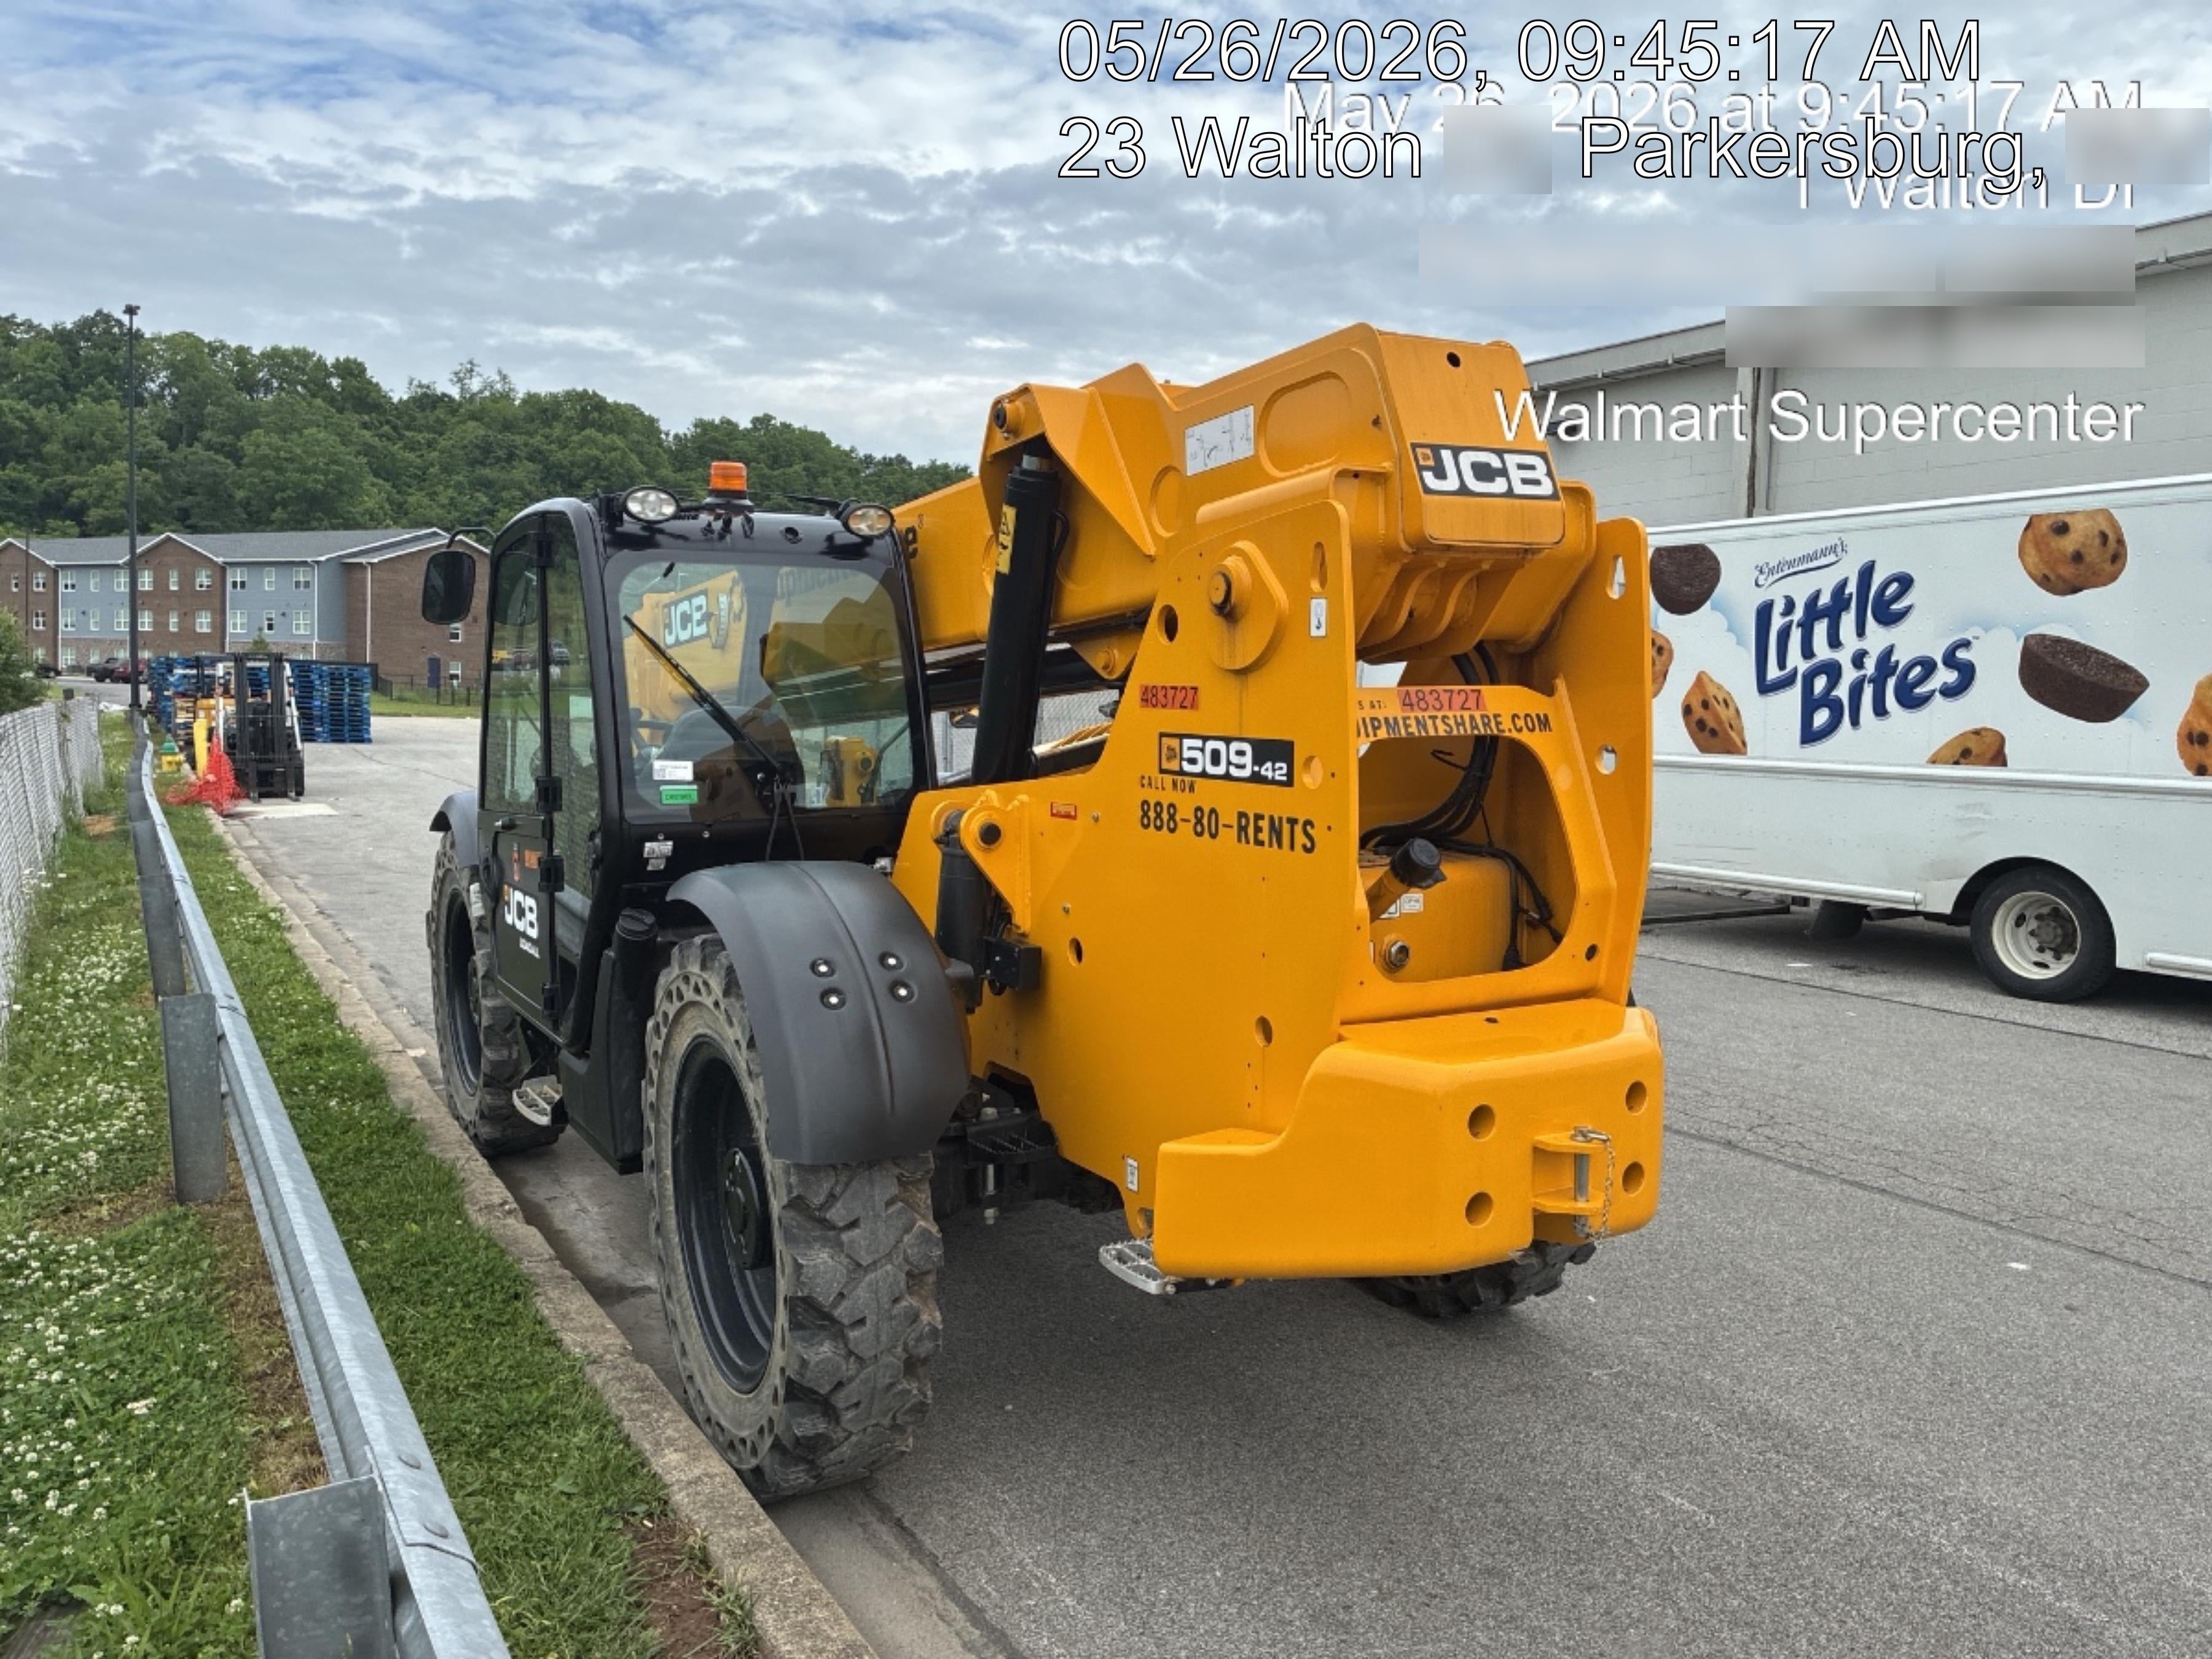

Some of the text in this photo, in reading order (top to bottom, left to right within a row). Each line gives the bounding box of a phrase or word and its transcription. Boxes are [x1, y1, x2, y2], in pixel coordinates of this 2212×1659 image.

[1422, 449, 1554, 496] JCB
[665, 595, 708, 645] JCB
[1755, 559, 1915, 696] Little
[1140, 685, 1198, 709] 483727
[1402, 688, 1481, 712] 483727
[1800, 637, 1977, 748] Bites
[1357, 712, 1553, 738] IPMENTSHARE.COM
[1181, 738, 1288, 781] 509-42
[1140, 775, 1197, 794] CALL NOW
[1140, 799, 1316, 854] 888-80-RENTS
[504, 887, 539, 939] JCB
